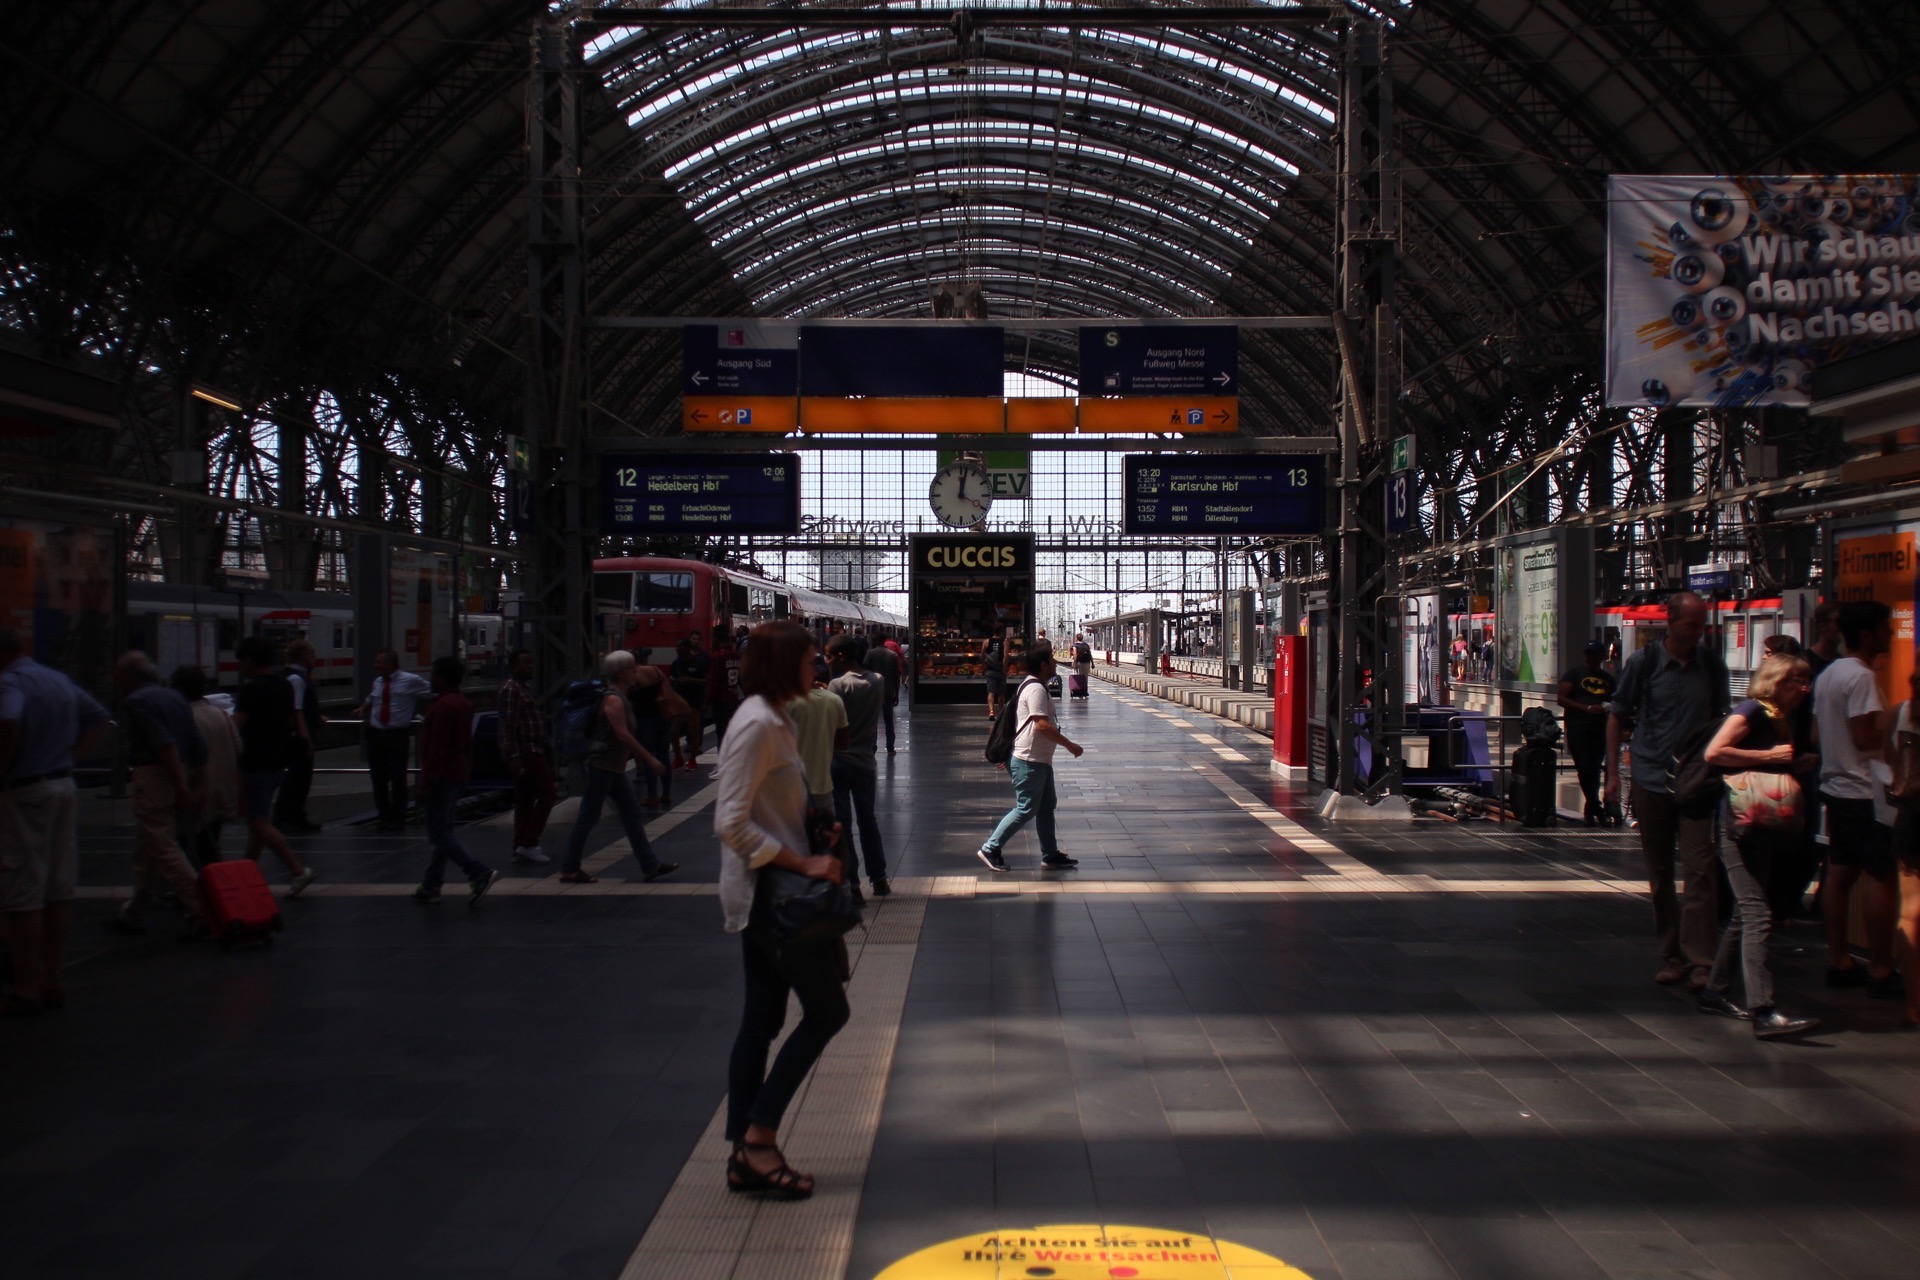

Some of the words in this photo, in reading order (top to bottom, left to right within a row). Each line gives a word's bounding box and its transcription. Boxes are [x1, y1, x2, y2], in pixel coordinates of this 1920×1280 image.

[1741, 233, 1808, 265] Wir
[1747, 267, 1861, 301] damit
[1871, 264, 1920, 295] Sie
[1106, 331, 1118, 347] S
[1146, 347, 1183, 359] Ausgang
[1184, 347, 1205, 357] Nord
[717, 359, 752, 369] Ausgang
[755, 359, 771, 367] Süd
[1143, 359, 1176, 370] Fußweg
[1178, 359, 1205, 368] Messe
[736, 409, 747, 424] P
[1192, 413, 1200, 424] P
[615, 468, 638, 487] 12
[762, 467, 785, 476] 12:06
[986, 472, 1028, 494] EV
[1137, 468, 1161, 477] 13:20
[1287, 468, 1309, 487] 13
[648, 480, 699, 494] Heidelberg
[702, 480, 720, 491] Hbf
[1170, 481, 1218, 492] Karlsruhe
[1222, 481, 1239, 492] Hbf
[1393, 477, 1407, 519] 13
[1205, 504, 1253, 513] Stadtallendorf
[682, 513, 717, 523] Heidelberg
[720, 513, 732, 521] Hbf
[800, 514, 904, 534] Software
[1205, 514, 1239, 524] Dillenburg
[927, 545, 1016, 568] CUCCIS
[1842, 541, 1911, 575] Himmel
[1841, 579, 1874, 602] und
[1892, 608, 1914, 619] kinder
[1902, 619, 1914, 629] not
[1897, 628, 1914, 639] hilfe
[983, 1235, 1088, 1249] Achten
[1094, 1235, 1138, 1249] Sie
[1145, 1235, 1193, 1249] auf
[962, 1248, 1027, 1262] Ihre
[1034, 1248, 1219, 1263] Wertsachen
